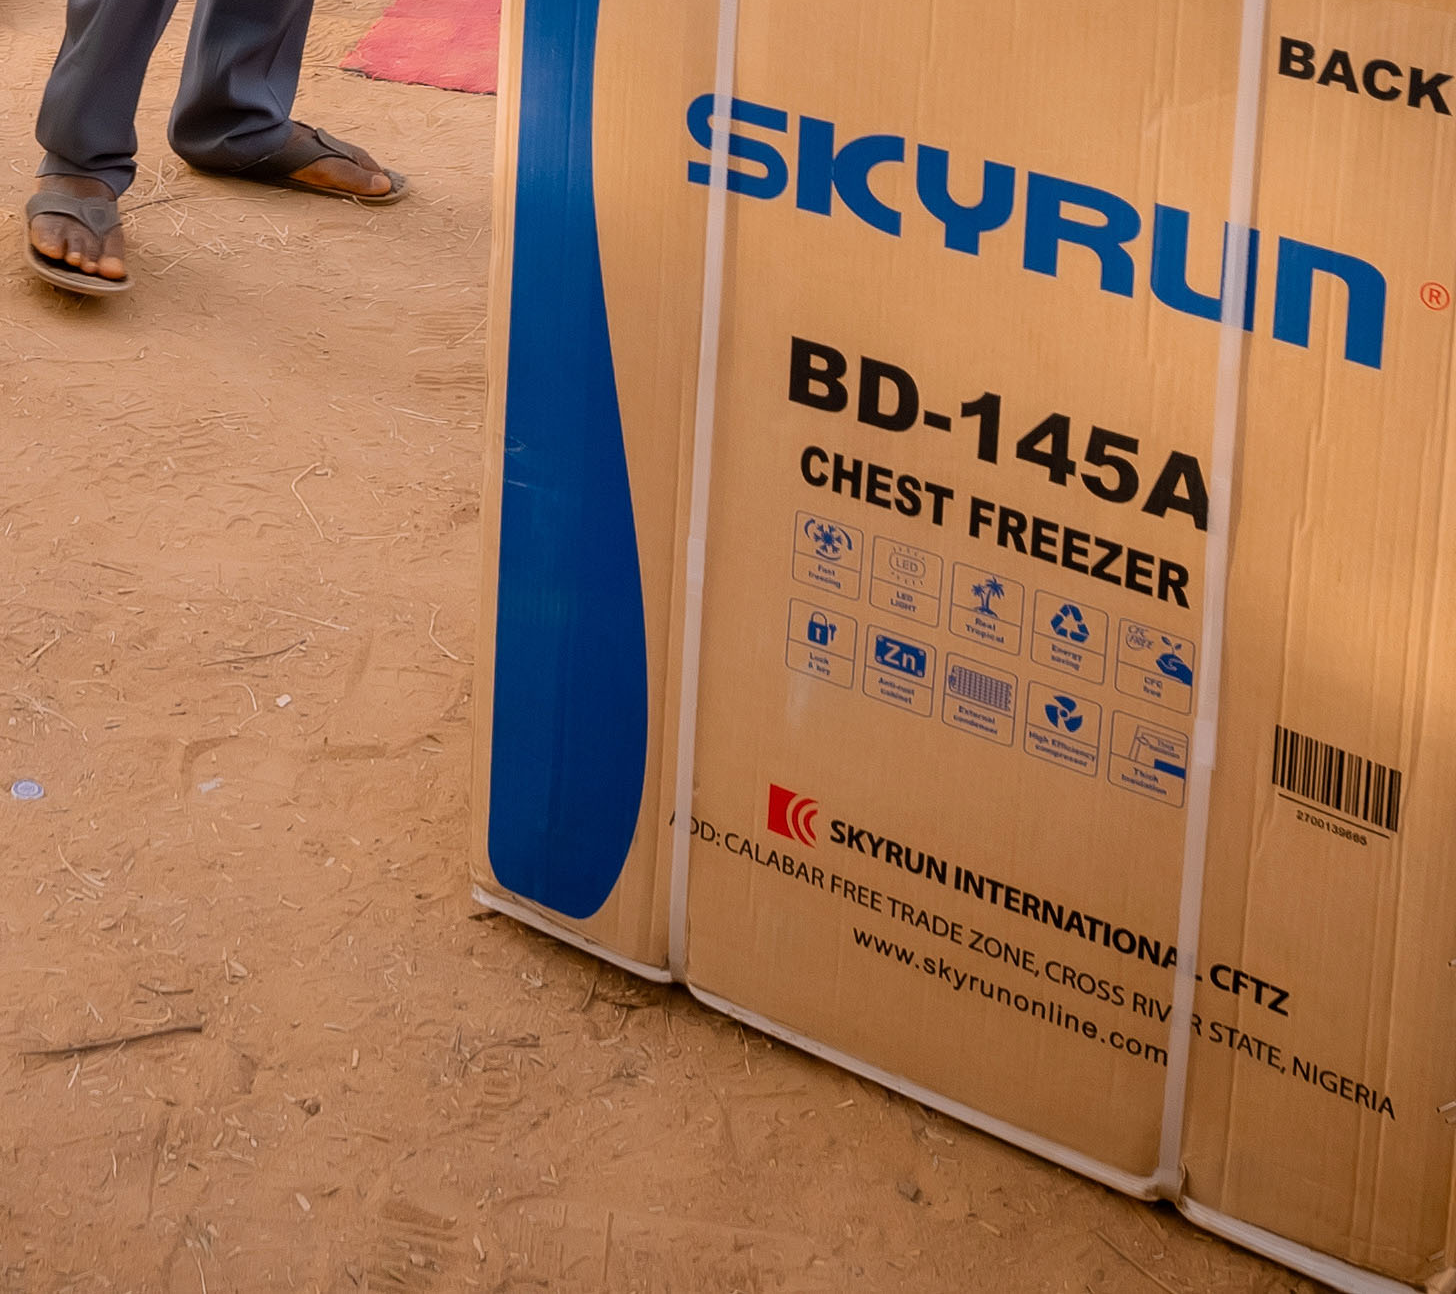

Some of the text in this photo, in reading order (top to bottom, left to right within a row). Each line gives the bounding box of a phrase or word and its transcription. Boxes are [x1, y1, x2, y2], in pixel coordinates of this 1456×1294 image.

[1279, 35, 1454, 116] BACK
[686, 93, 1387, 370] SKYRUN
[788, 335, 1210, 532] BD-145A
[800, 445, 1191, 610] CHEST FREEZER
[818, 564, 835, 576] Fast
[896, 557, 919, 573] LED
[890, 598, 917, 612] LIGHT
[896, 591, 913, 602] LED
[965, 624, 1005, 644] Tropical
[975, 618, 996, 631] Real
[809, 652, 829, 665] Lock
[884, 642, 916, 670] Zn
[1051, 655, 1080, 671] saving
[816, 664, 831, 676] key
[878, 676, 915, 695] Anti-rust
[1143, 686, 1163, 699] free
[958, 705, 996, 724] External
[1029, 731, 1049, 744] High
[829, 819, 1291, 1017] SKYRUN INTERNATIONA CFTZ
[724, 832, 826, 890] CALABAR
[830, 874, 883, 913] FREE
[887, 896, 964, 946] TRADE
[968, 929, 1041, 978] ZONE,
[1045, 960, 1125, 1007] CROSS
[1132, 991, 1203, 1037] RIVR
[1209, 1020, 1287, 1075] STATE,
[1292, 1055, 1397, 1121] NIGERIA
[852, 926, 1169, 1067] www.skyrunonline.com
